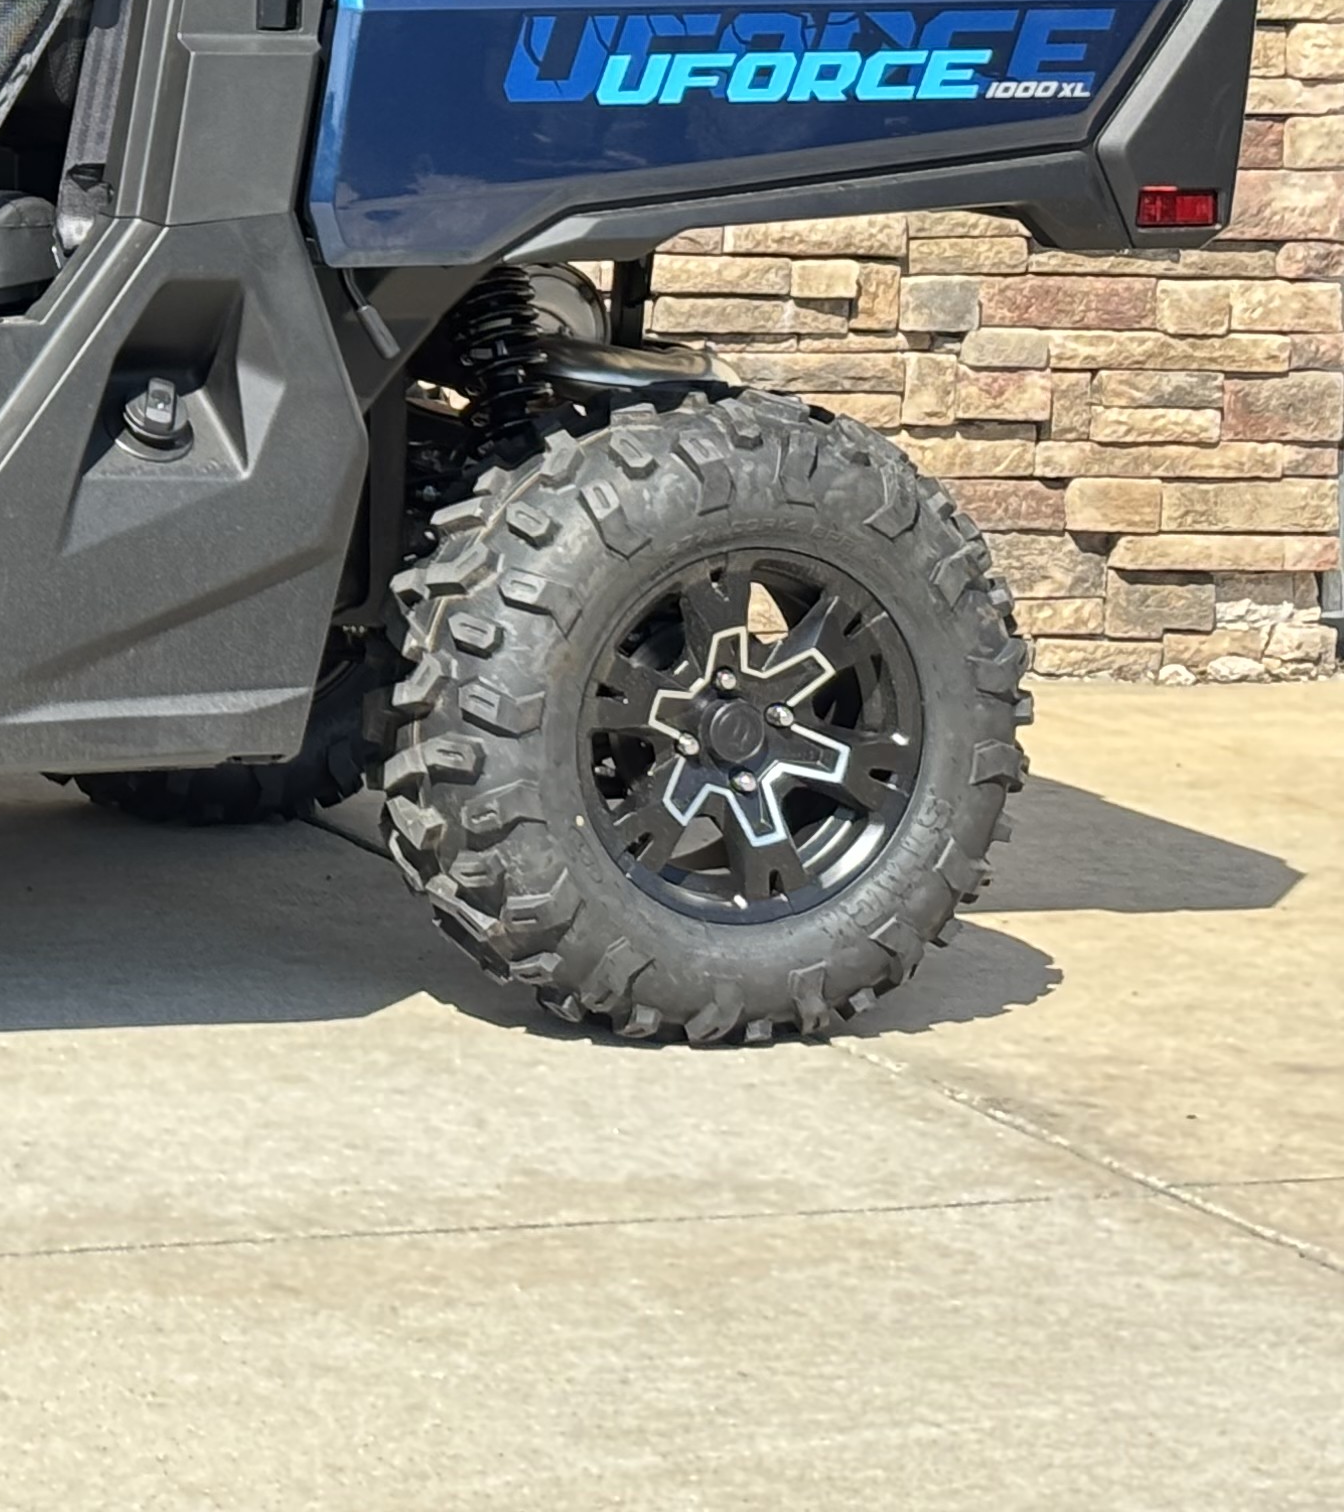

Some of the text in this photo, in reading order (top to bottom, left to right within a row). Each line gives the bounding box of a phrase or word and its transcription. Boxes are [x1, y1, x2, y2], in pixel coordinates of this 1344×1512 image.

[596, 49, 993, 105] UFORCE
[985, 81, 1091, 99] 1000 XL
